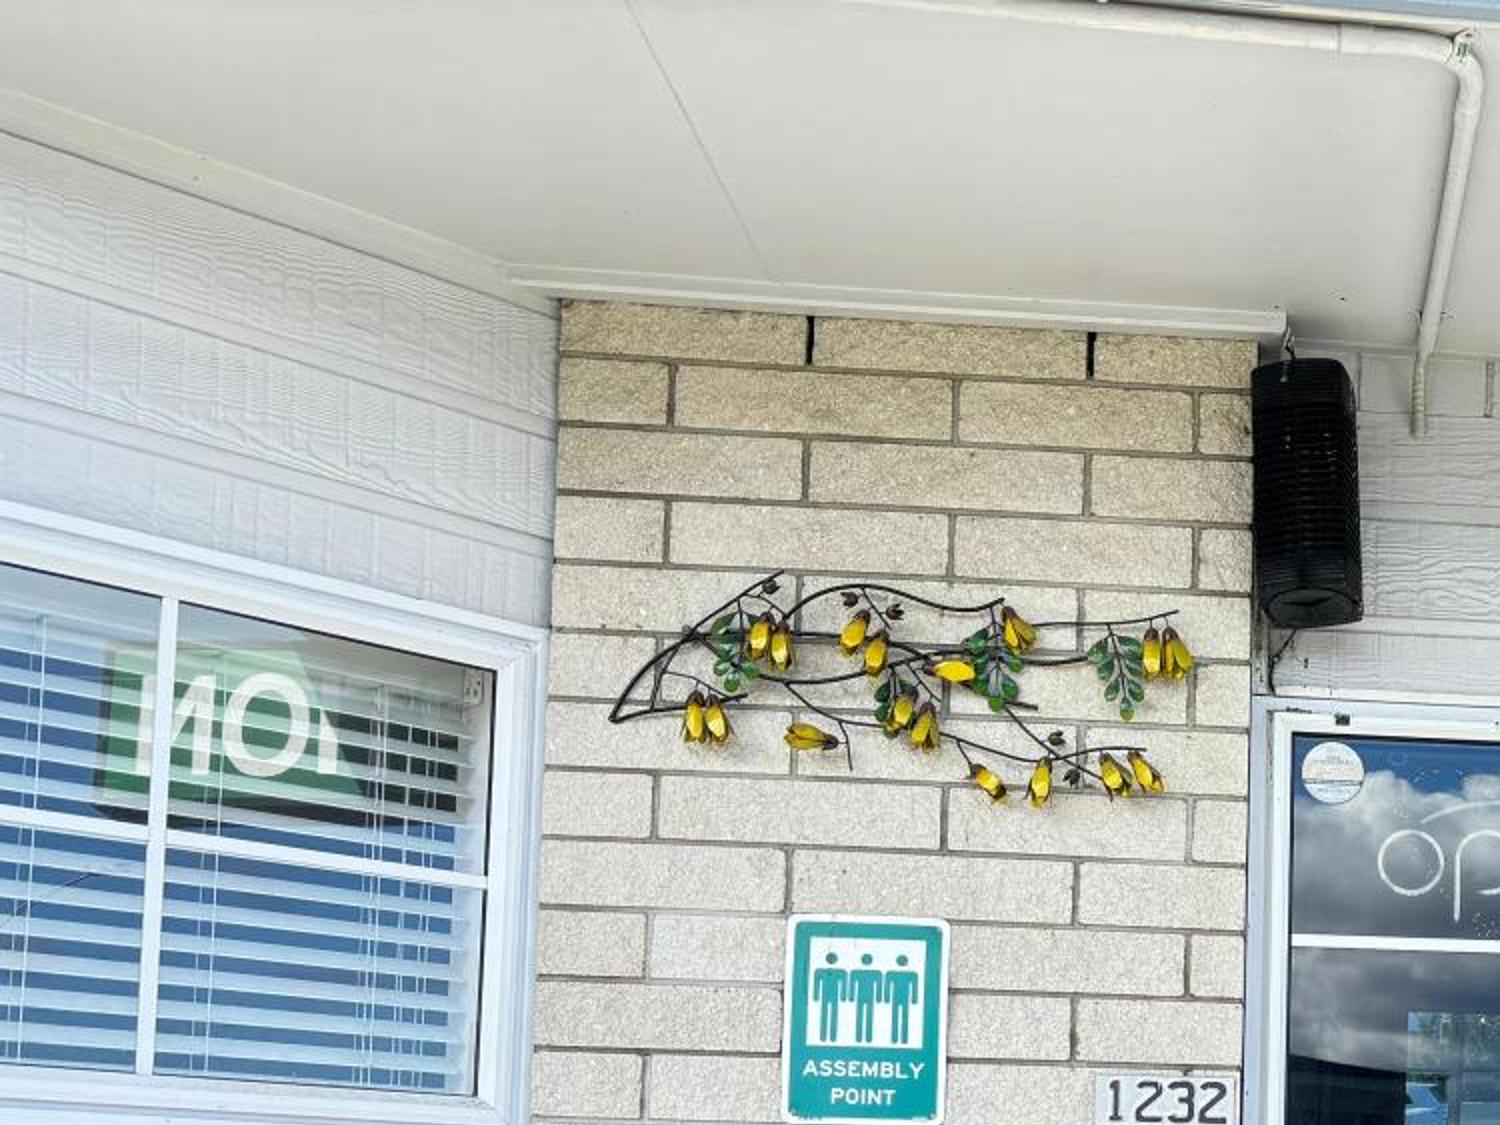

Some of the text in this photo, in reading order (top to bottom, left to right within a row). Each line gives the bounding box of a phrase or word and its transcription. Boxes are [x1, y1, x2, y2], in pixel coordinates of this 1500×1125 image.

[802, 1060, 925, 1079] ASSEMBLY
[831, 1088, 897, 1105] POINT
[1108, 1080, 1229, 1125] 1232
